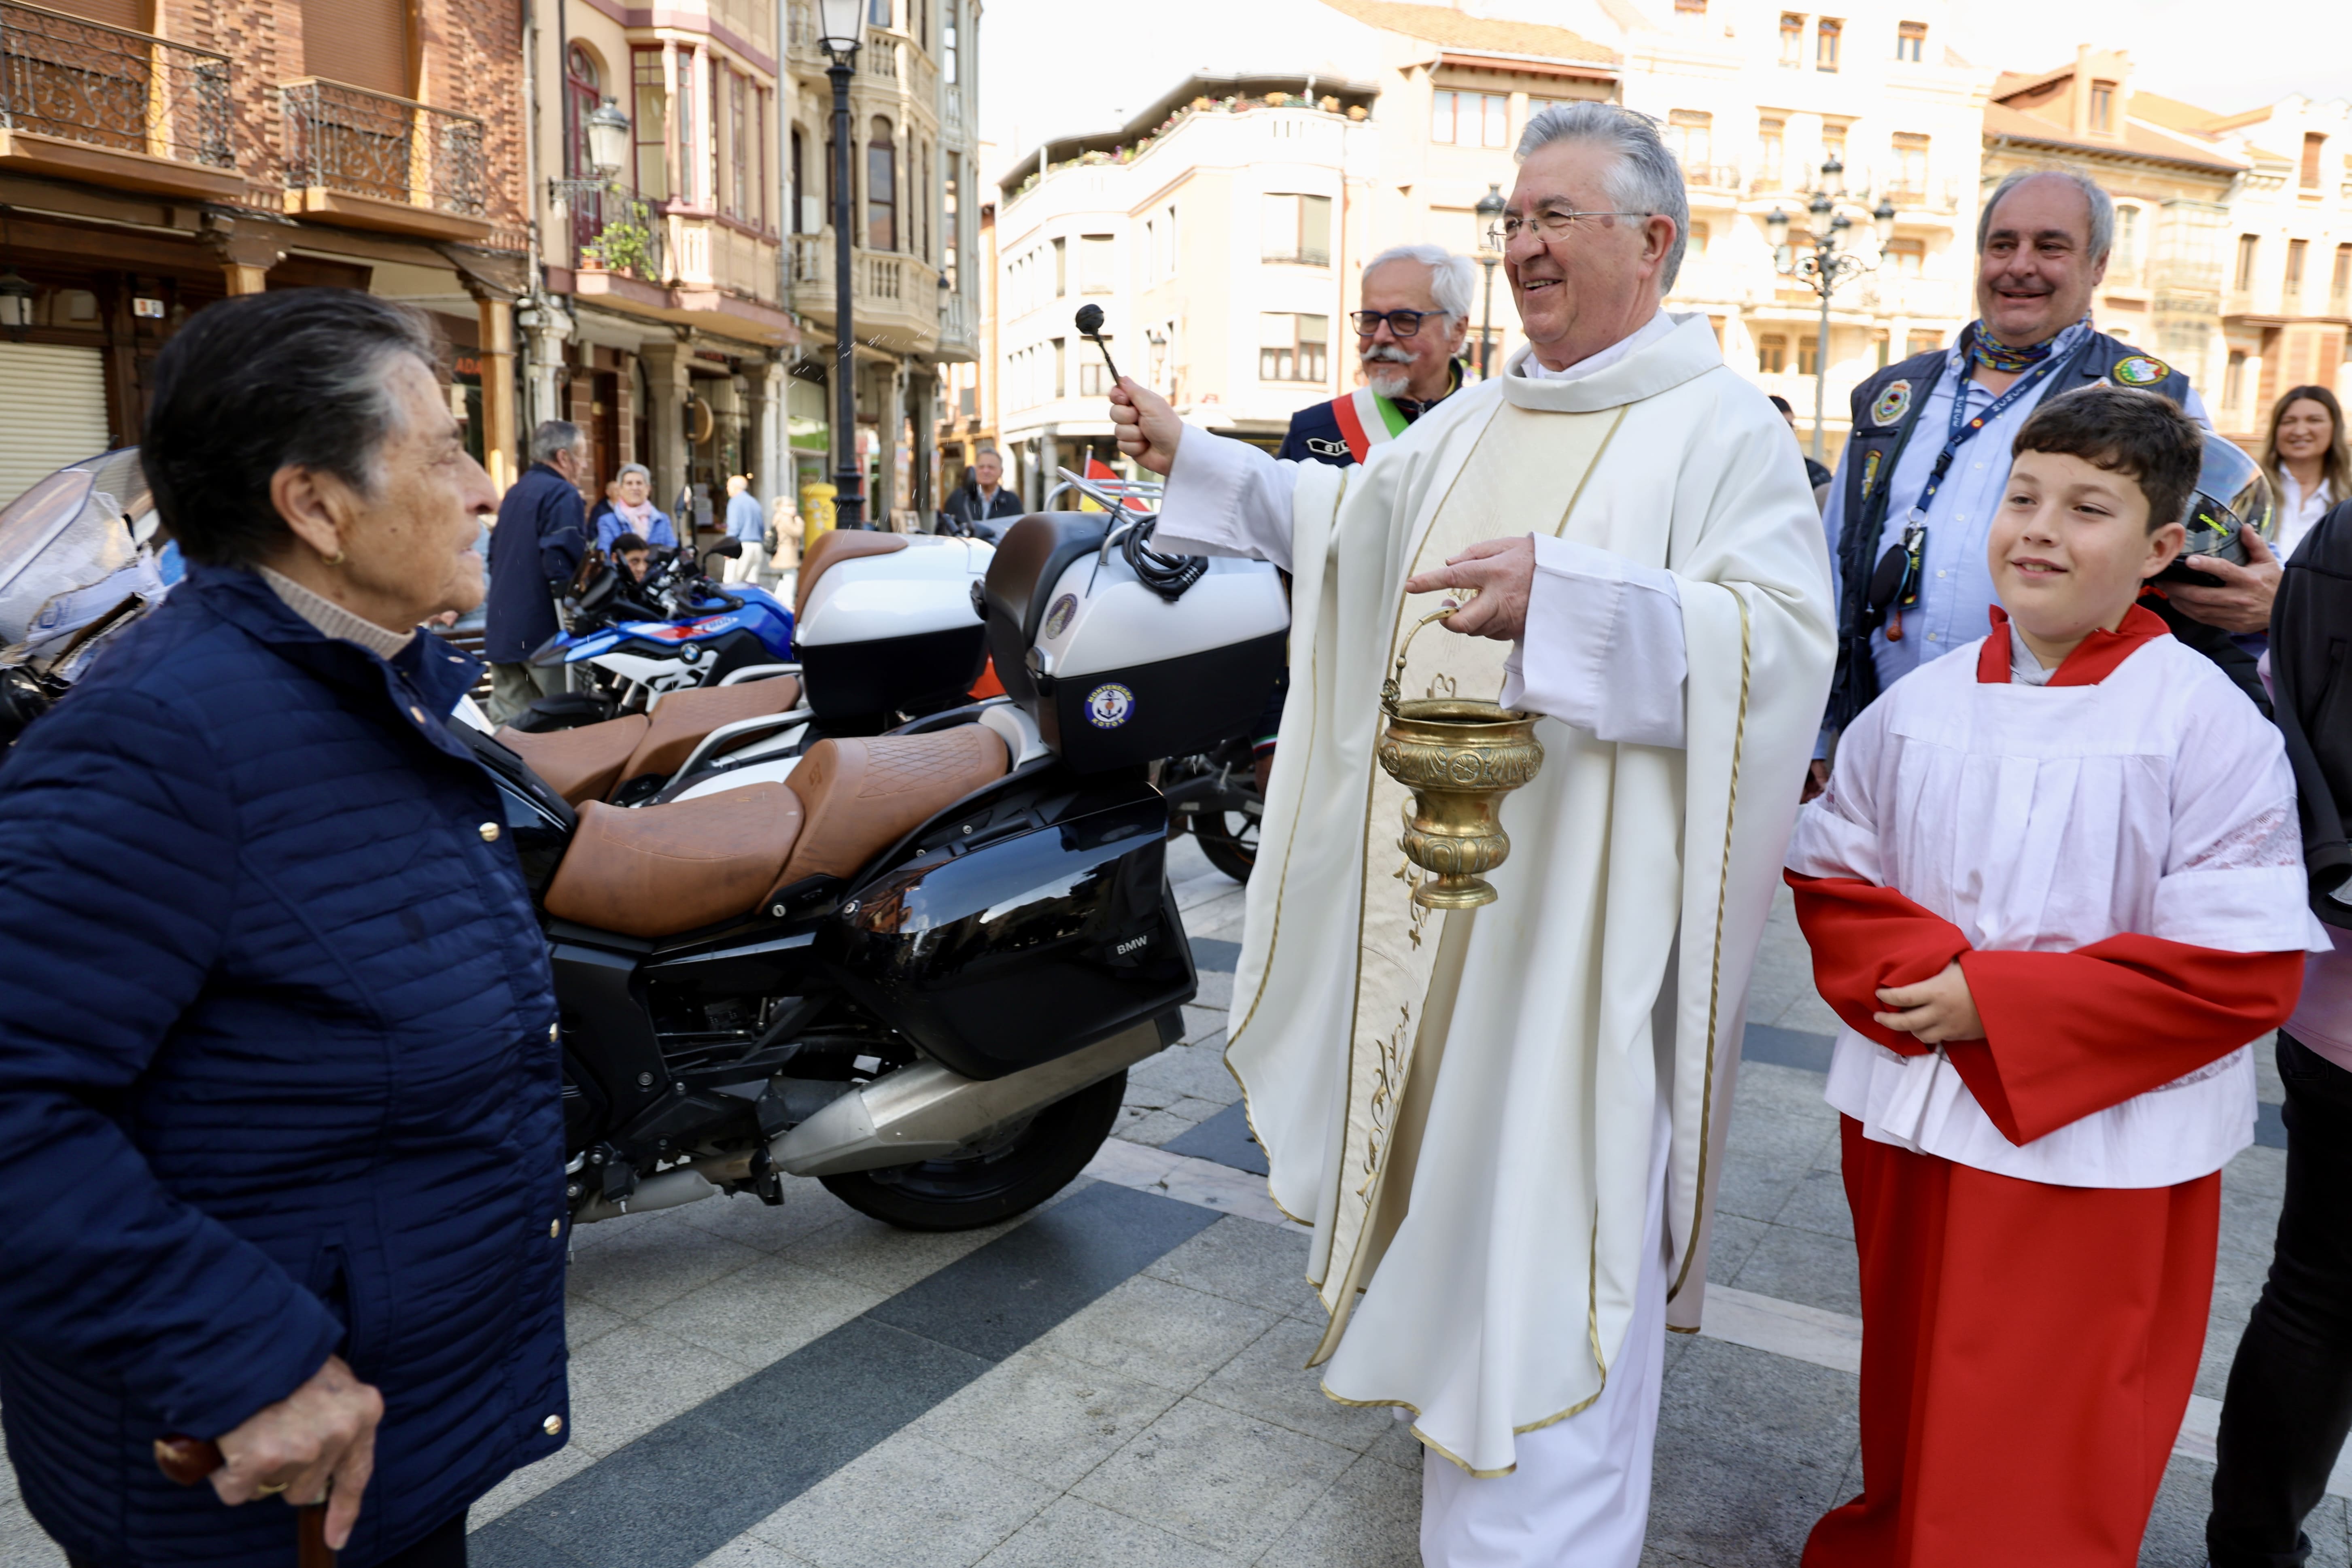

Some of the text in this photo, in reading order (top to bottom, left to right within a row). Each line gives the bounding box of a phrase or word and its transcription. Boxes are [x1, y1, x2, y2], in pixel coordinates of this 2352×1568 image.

[1087, 685, 1133, 703] MONTENEGRO
[1091, 718, 1125, 727] KOTOR
[1117, 935, 1147, 955] BMW
